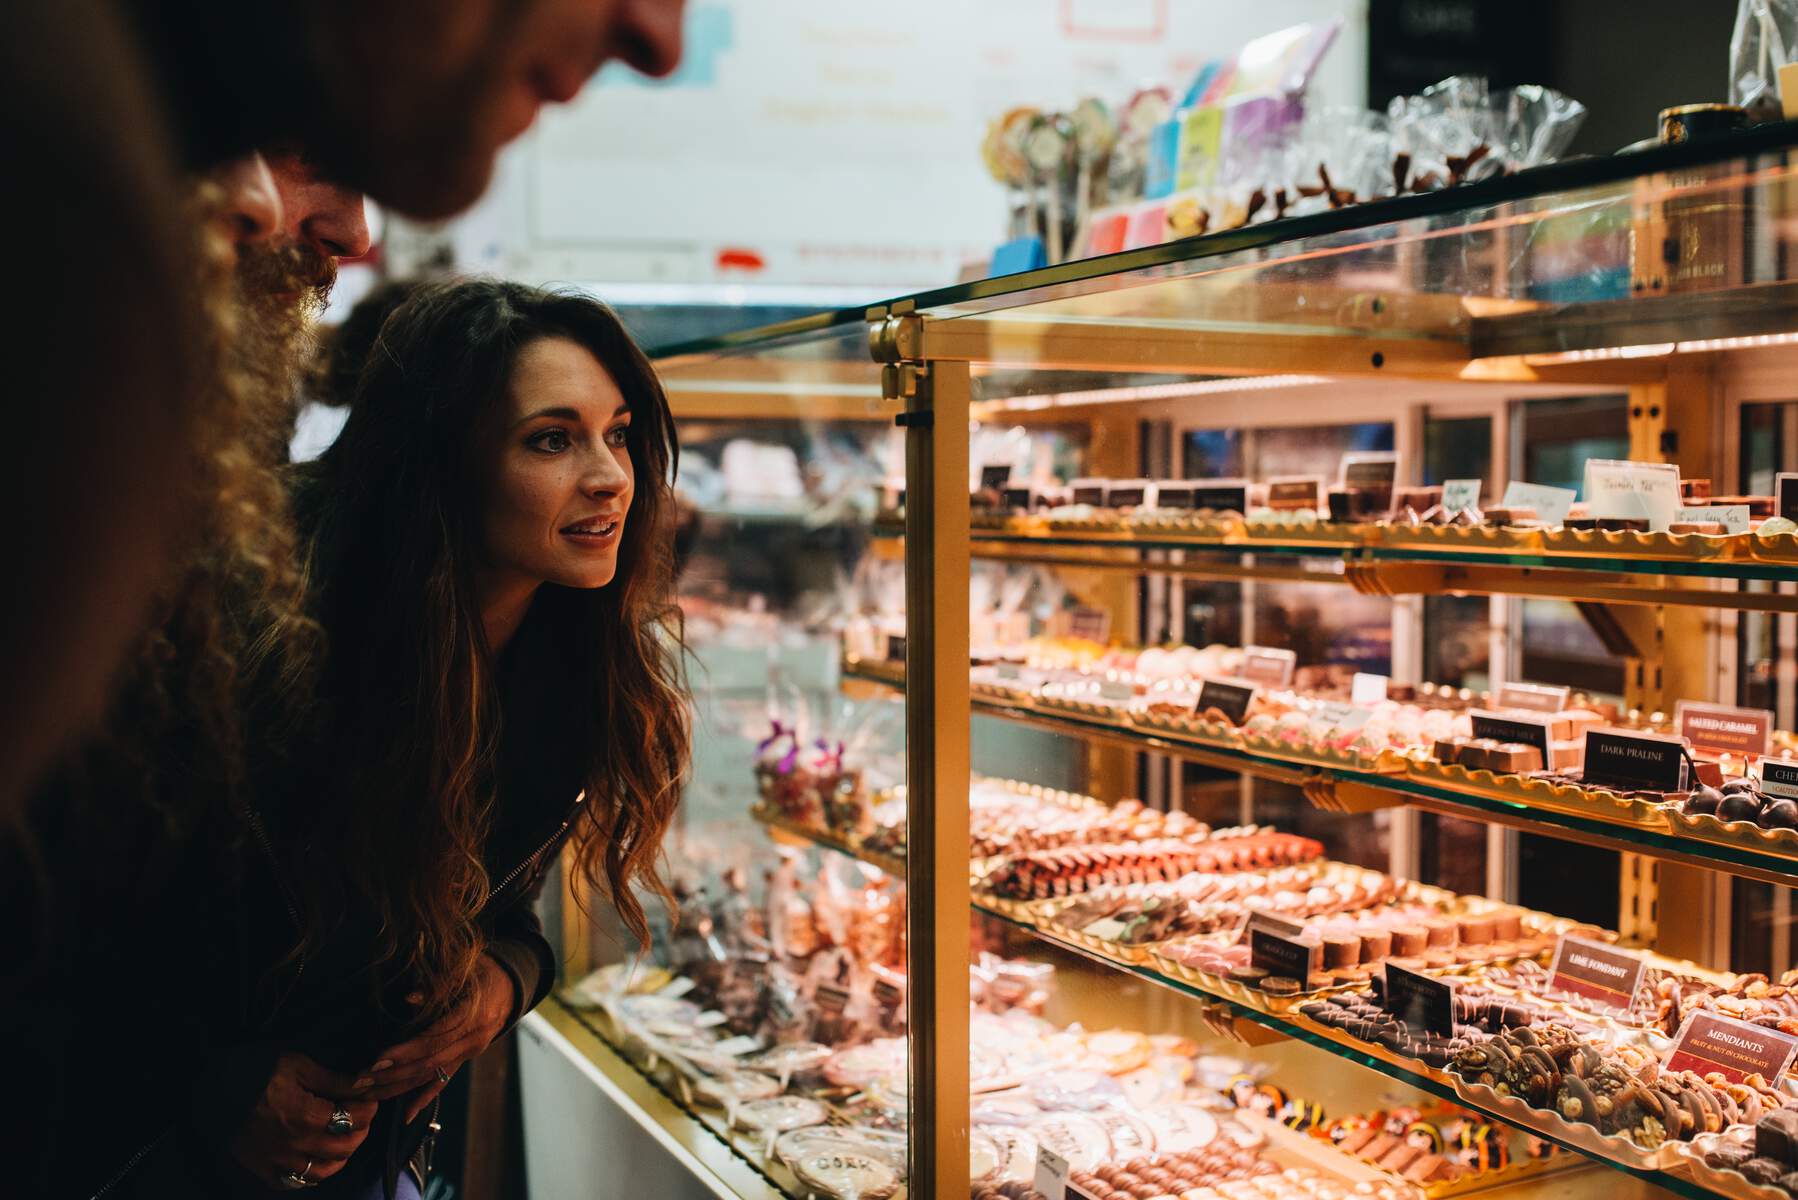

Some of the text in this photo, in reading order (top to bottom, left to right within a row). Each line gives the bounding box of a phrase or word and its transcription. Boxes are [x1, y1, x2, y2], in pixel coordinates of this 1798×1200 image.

[1688, 716, 1758, 734] SALTED CARAMEL
[1600, 744, 1664, 761] DARK PRALINE
[1568, 953, 1628, 978] LIME FONDANT
[1707, 1029, 1765, 1053] MENDIANTS
[1689, 1038, 1709, 1048] FRUIT
[1712, 1046, 1727, 1054] NUT
[1733, 1052, 1769, 1069] CHOCOLATE
[817, 1156, 875, 1172] CORK
